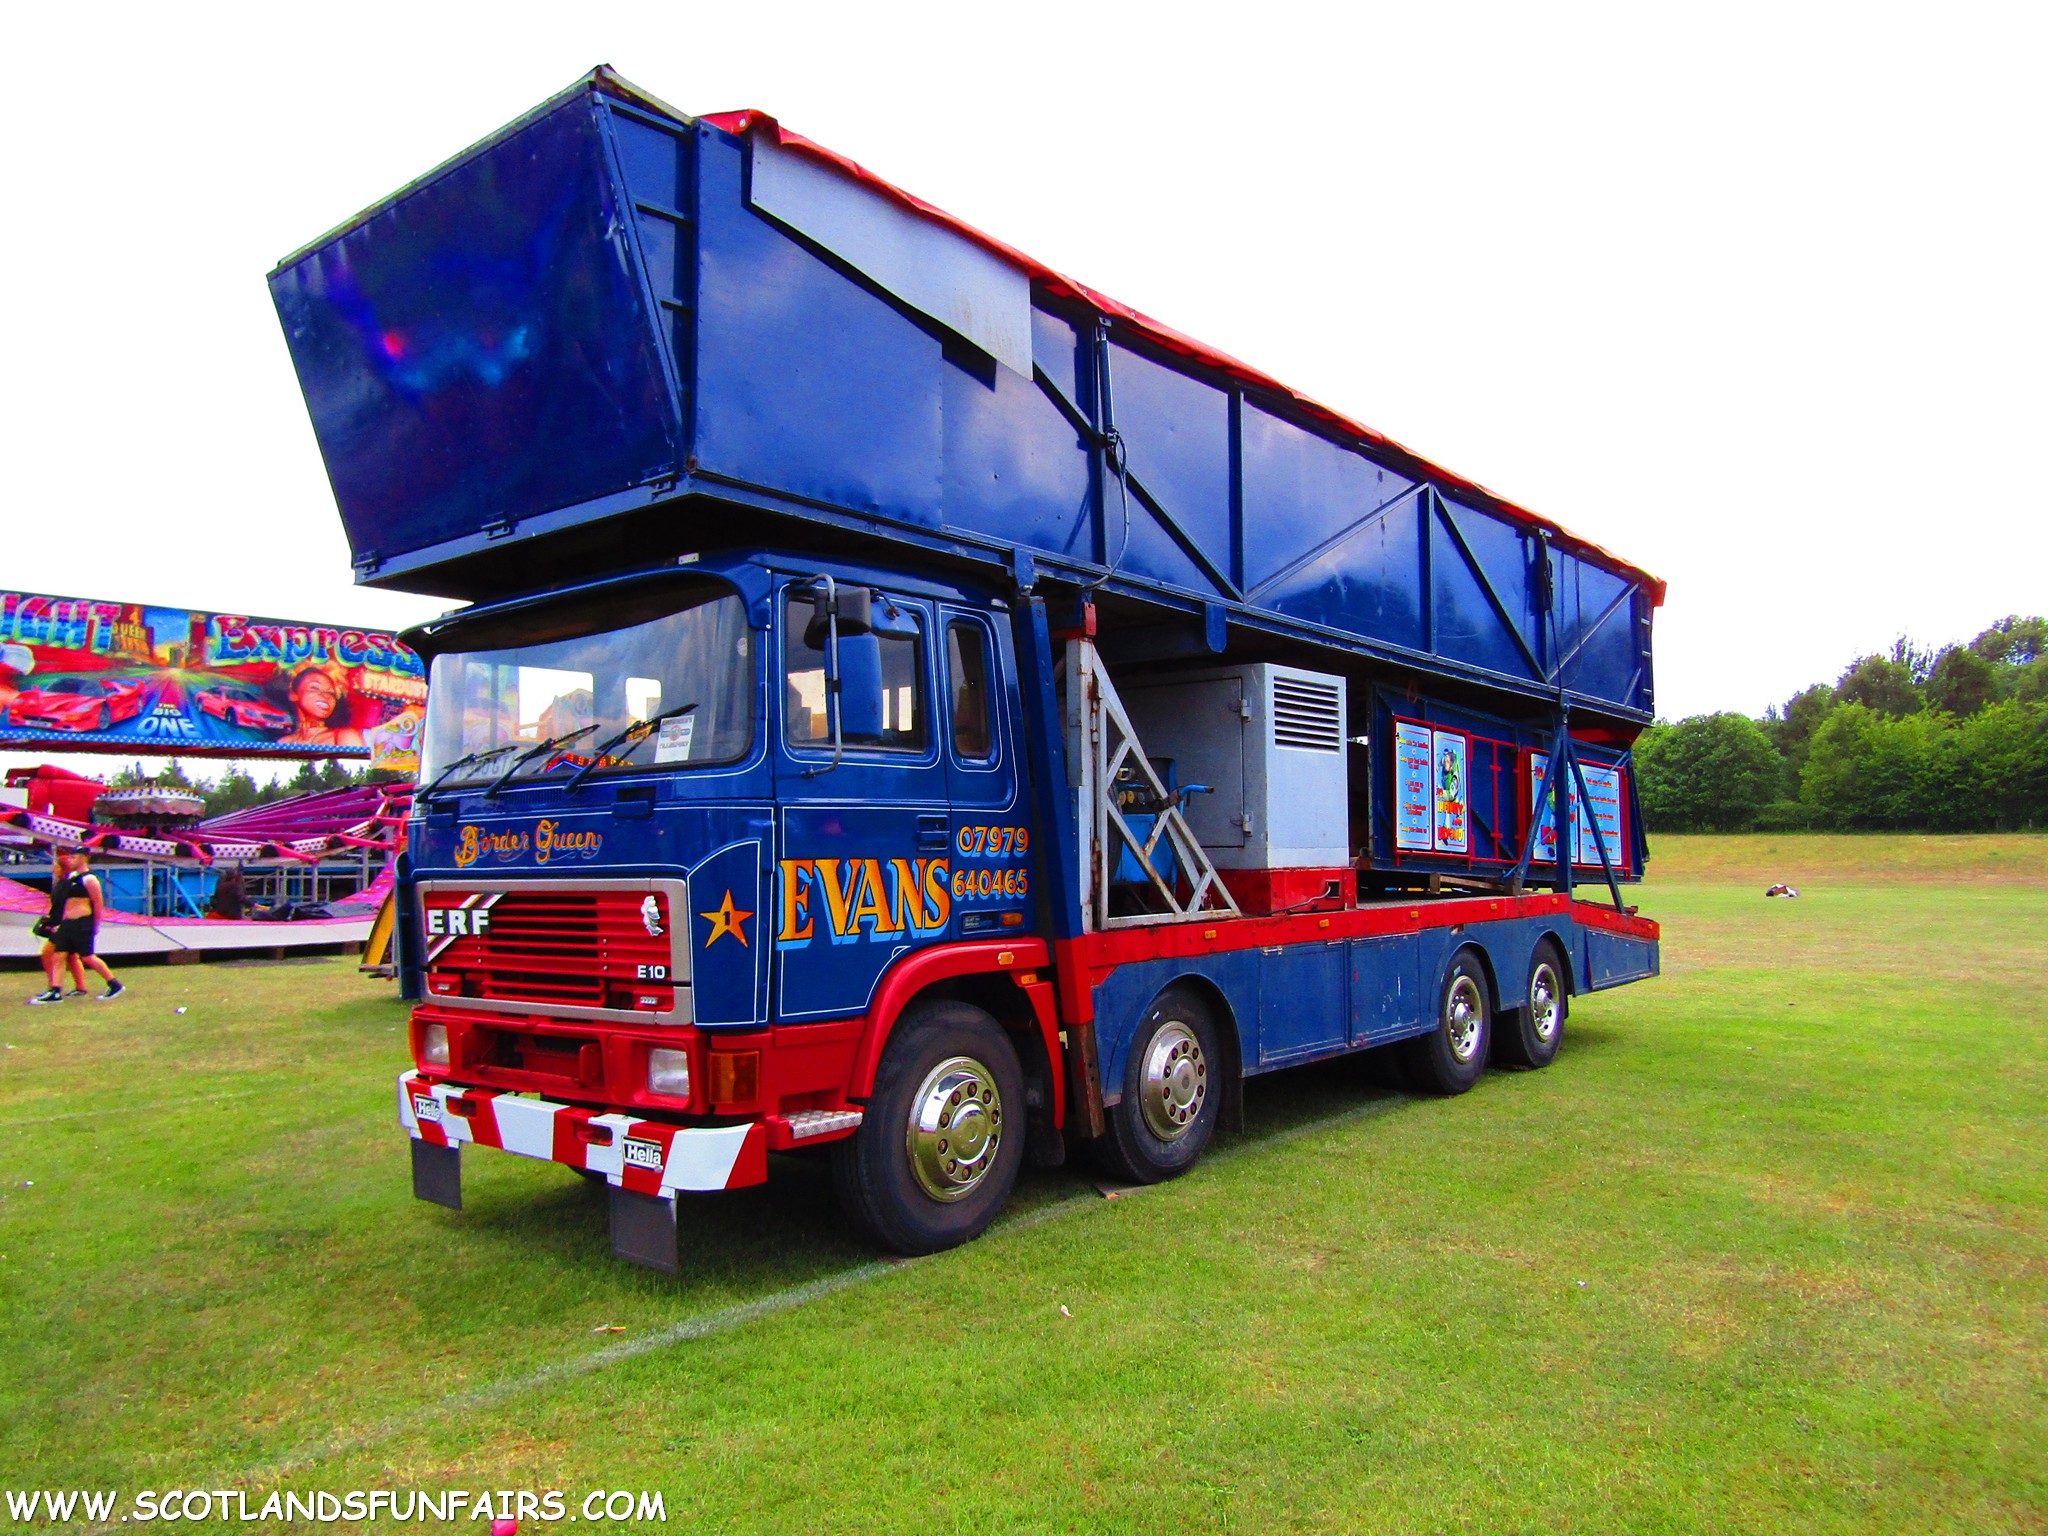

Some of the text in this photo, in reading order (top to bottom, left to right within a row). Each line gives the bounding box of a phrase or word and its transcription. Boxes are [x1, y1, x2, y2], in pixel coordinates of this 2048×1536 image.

[207, 615, 426, 677] Express
[152, 707, 182, 717] BIG
[136, 716, 203, 738] ONE
[454, 819, 602, 868] Border Queen
[956, 825, 1029, 857] 07979
[951, 868, 1029, 900] 640465
[776, 857, 951, 950] EVANS
[427, 909, 490, 936] ERF
[722, 910, 732, 926] 1
[637, 964, 666, 979] E10
[627, 1144, 662, 1165] Hella
